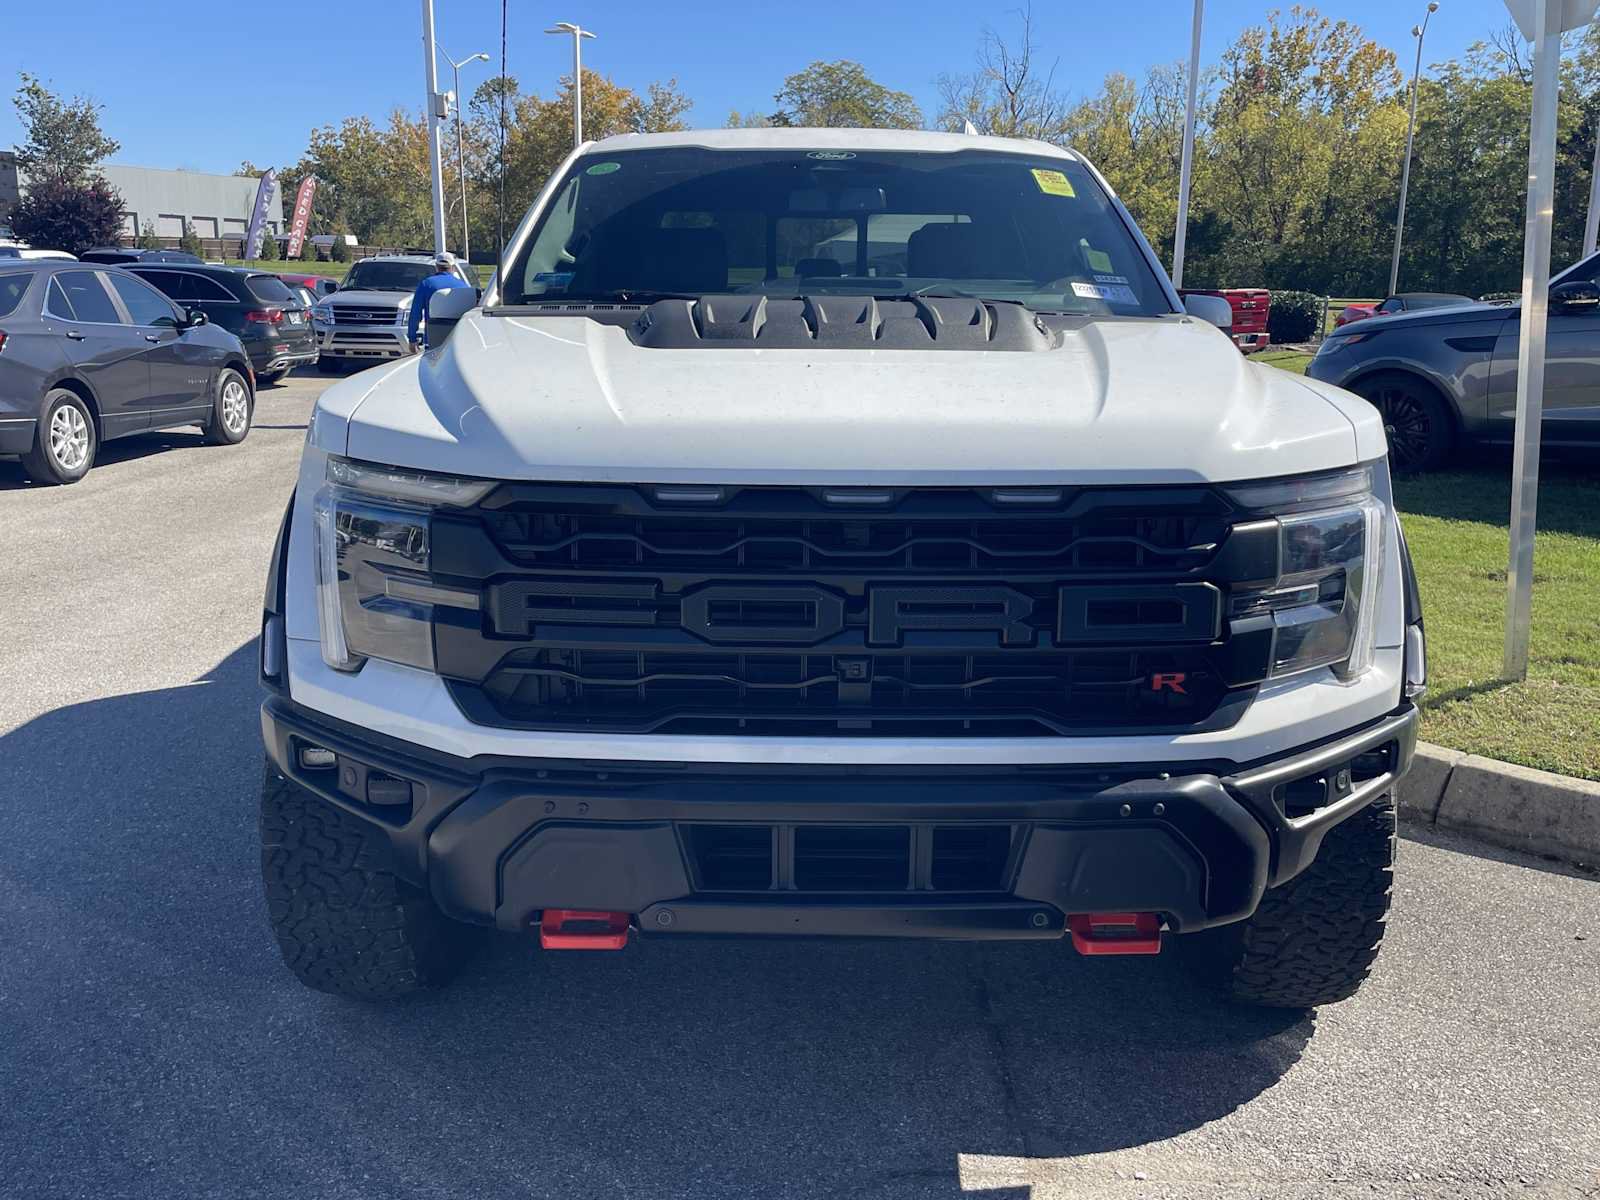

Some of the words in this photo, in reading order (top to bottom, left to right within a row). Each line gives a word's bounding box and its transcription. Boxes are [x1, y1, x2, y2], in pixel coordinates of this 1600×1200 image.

[298, 178, 312, 215] USED
[287, 219, 304, 256] CARS
[493, 580, 1221, 646] FORD
[1152, 673, 1187, 694] R
